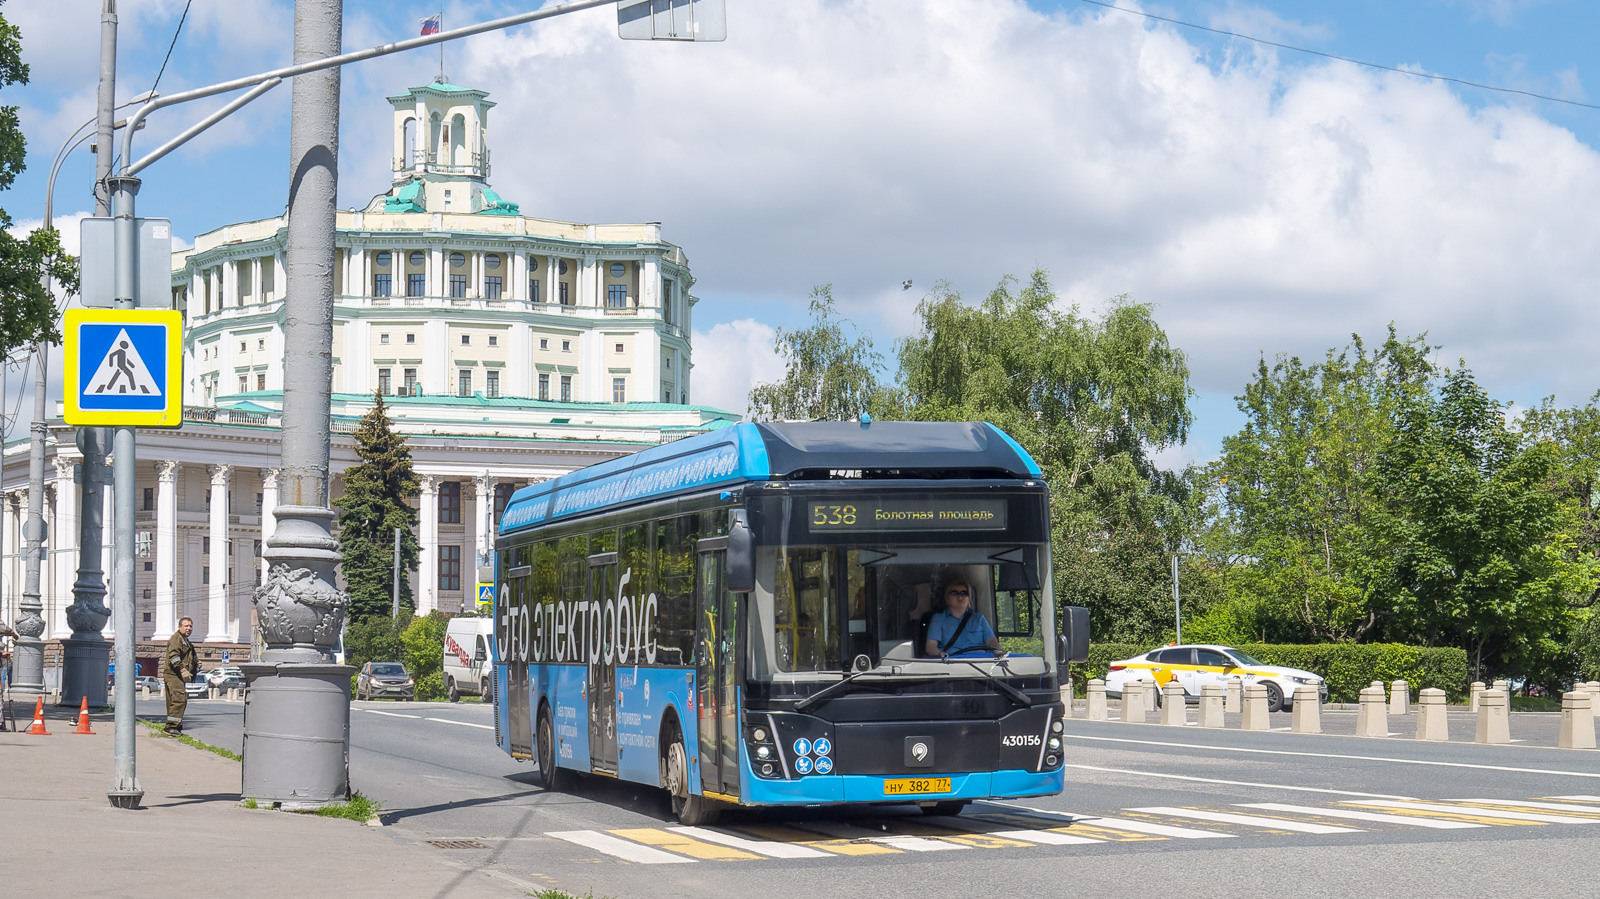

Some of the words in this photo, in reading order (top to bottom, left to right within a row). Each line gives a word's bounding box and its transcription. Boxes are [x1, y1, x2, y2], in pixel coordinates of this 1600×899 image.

[813, 505, 857, 525] 538
[875, 509, 934, 520] Болотная
[939, 509, 994, 522] площадь
[498, 582, 530, 663] Это
[533, 566, 658, 686] электробус
[1002, 735, 1041, 747] 430156
[909, 780, 930, 792] 382
[936, 779, 947, 788] 77
